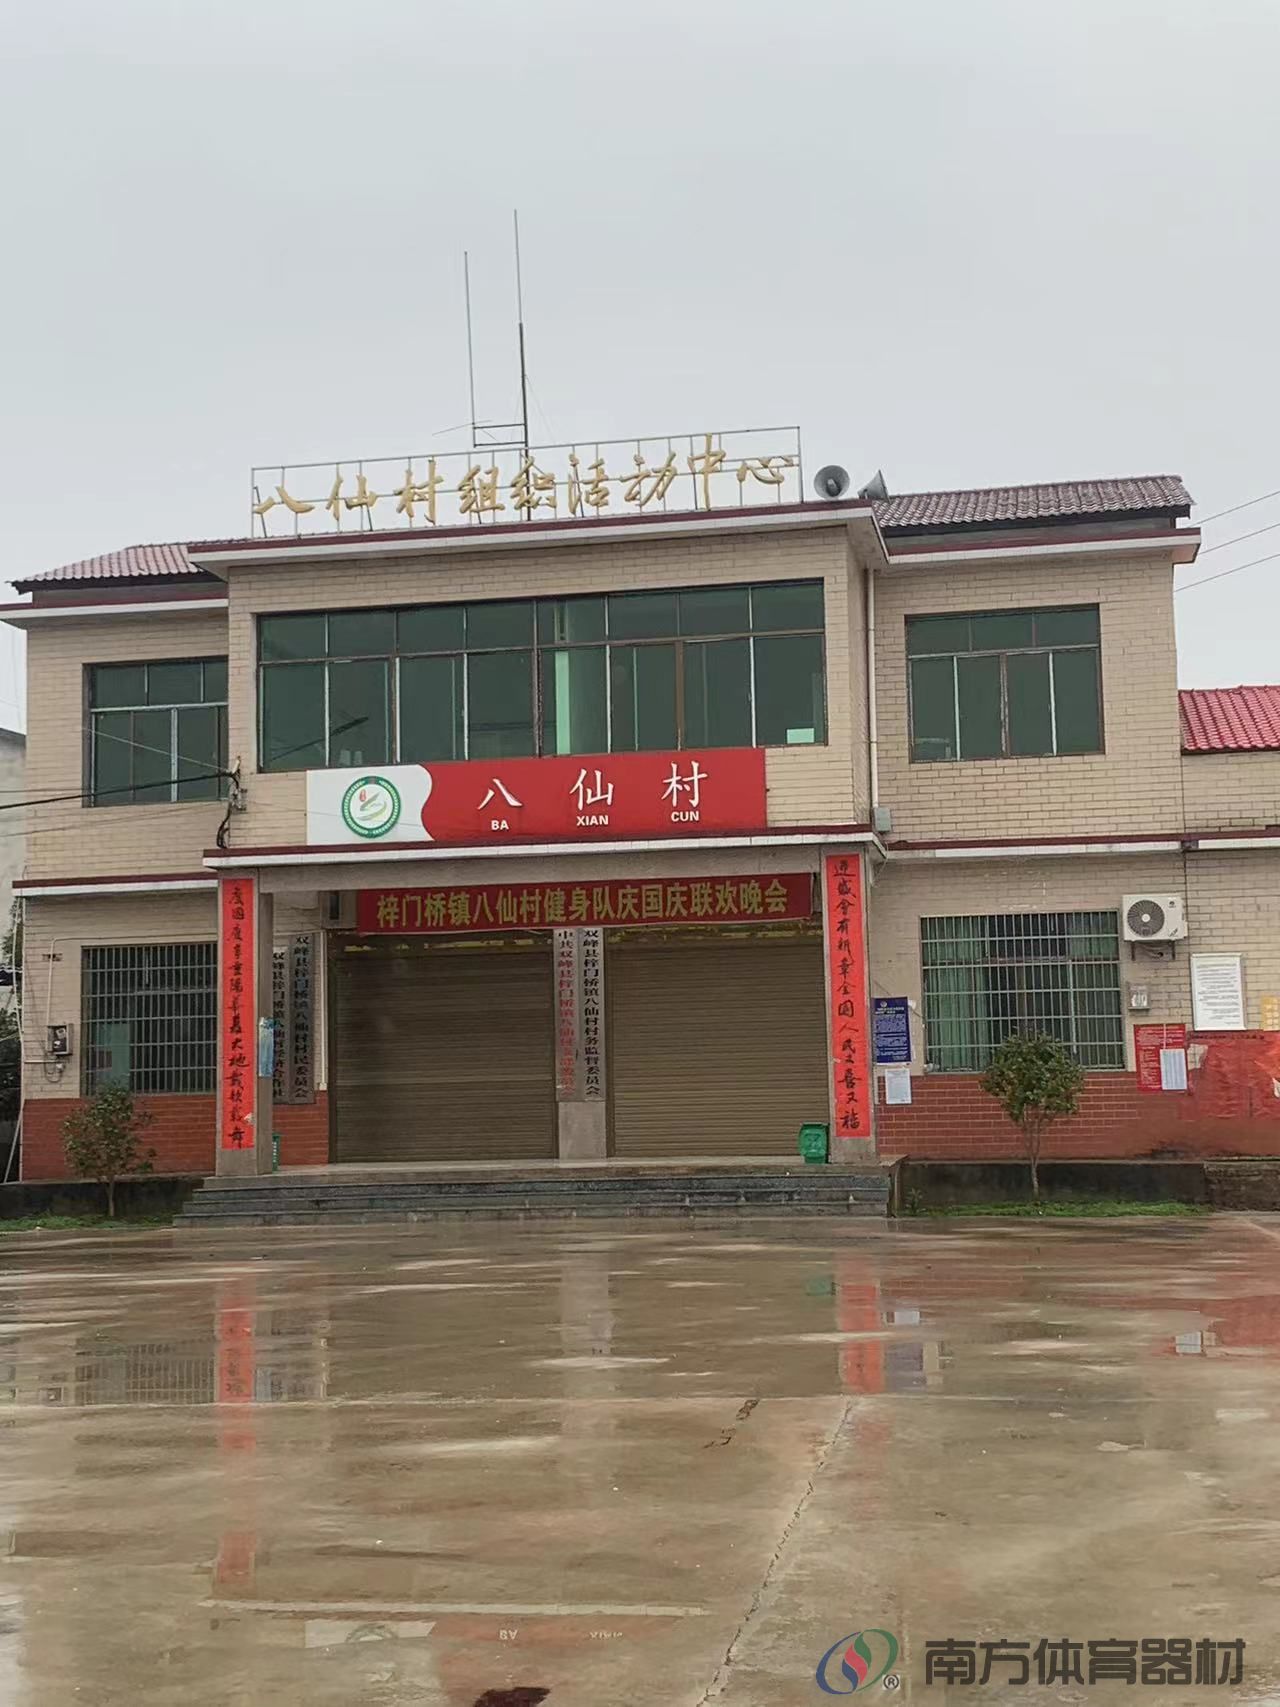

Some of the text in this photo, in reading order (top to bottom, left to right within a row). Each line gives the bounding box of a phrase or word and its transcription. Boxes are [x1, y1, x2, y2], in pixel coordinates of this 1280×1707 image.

[253, 434, 794, 524] 八仙村组织活动中心
[477, 761, 709, 811] 八仙村
[491, 811, 700, 832] BA XIAN CUN
[376, 878, 788, 928] 梓门桥镇八仙村健身队庆国庆联欢晚会
